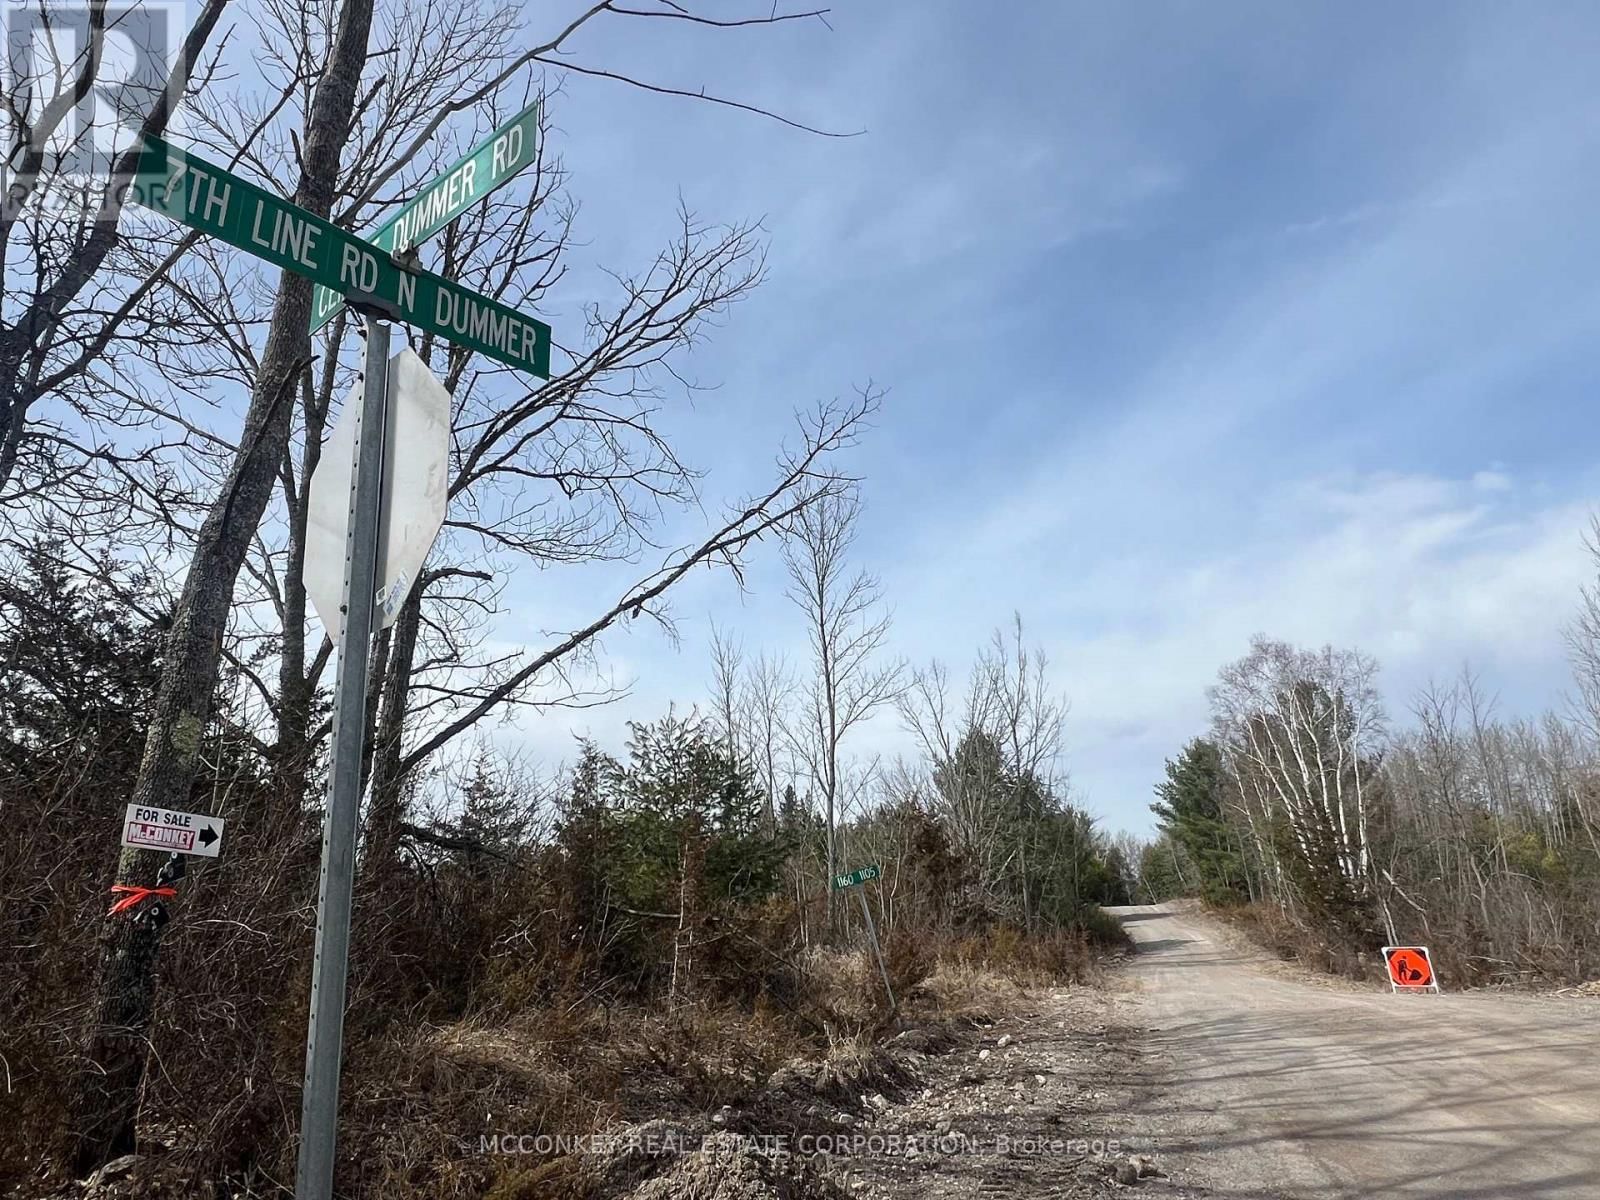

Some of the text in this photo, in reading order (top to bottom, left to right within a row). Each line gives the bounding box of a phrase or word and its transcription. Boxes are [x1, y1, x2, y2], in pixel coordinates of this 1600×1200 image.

[393, 124, 523, 254] DUMMER RD
[163, 156, 231, 228] 7TH
[251, 199, 322, 270] LINE
[340, 242, 378, 293] RD
[397, 270, 416, 313] N
[435, 286, 536, 365] DUMMER
[135, 808, 192, 828] FOR SALE
[837, 866, 876, 888] 1160 1105
